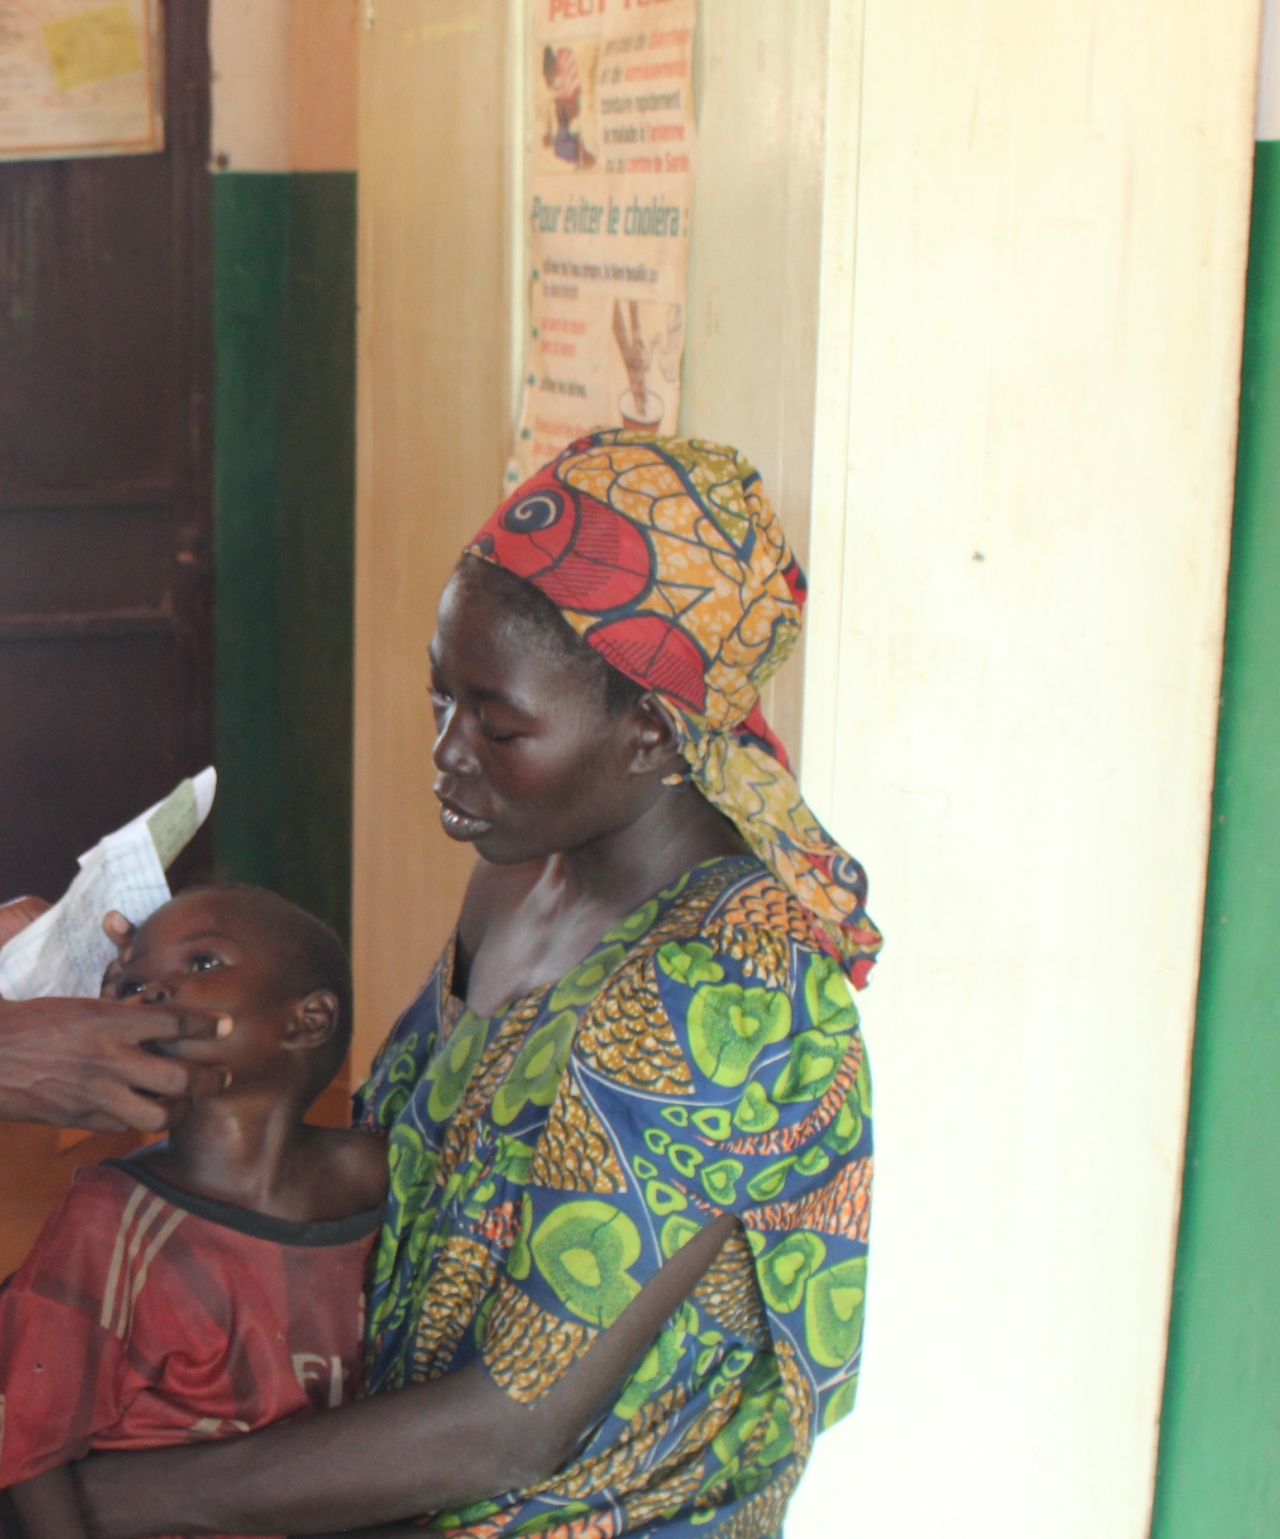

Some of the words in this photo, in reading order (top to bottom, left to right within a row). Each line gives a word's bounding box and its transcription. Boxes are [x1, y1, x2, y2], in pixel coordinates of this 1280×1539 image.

[531, 195, 562, 233] Pour
[563, 194, 605, 235] éviter
[607, 195, 620, 236] le
[623, 194, 681, 237] choléra
